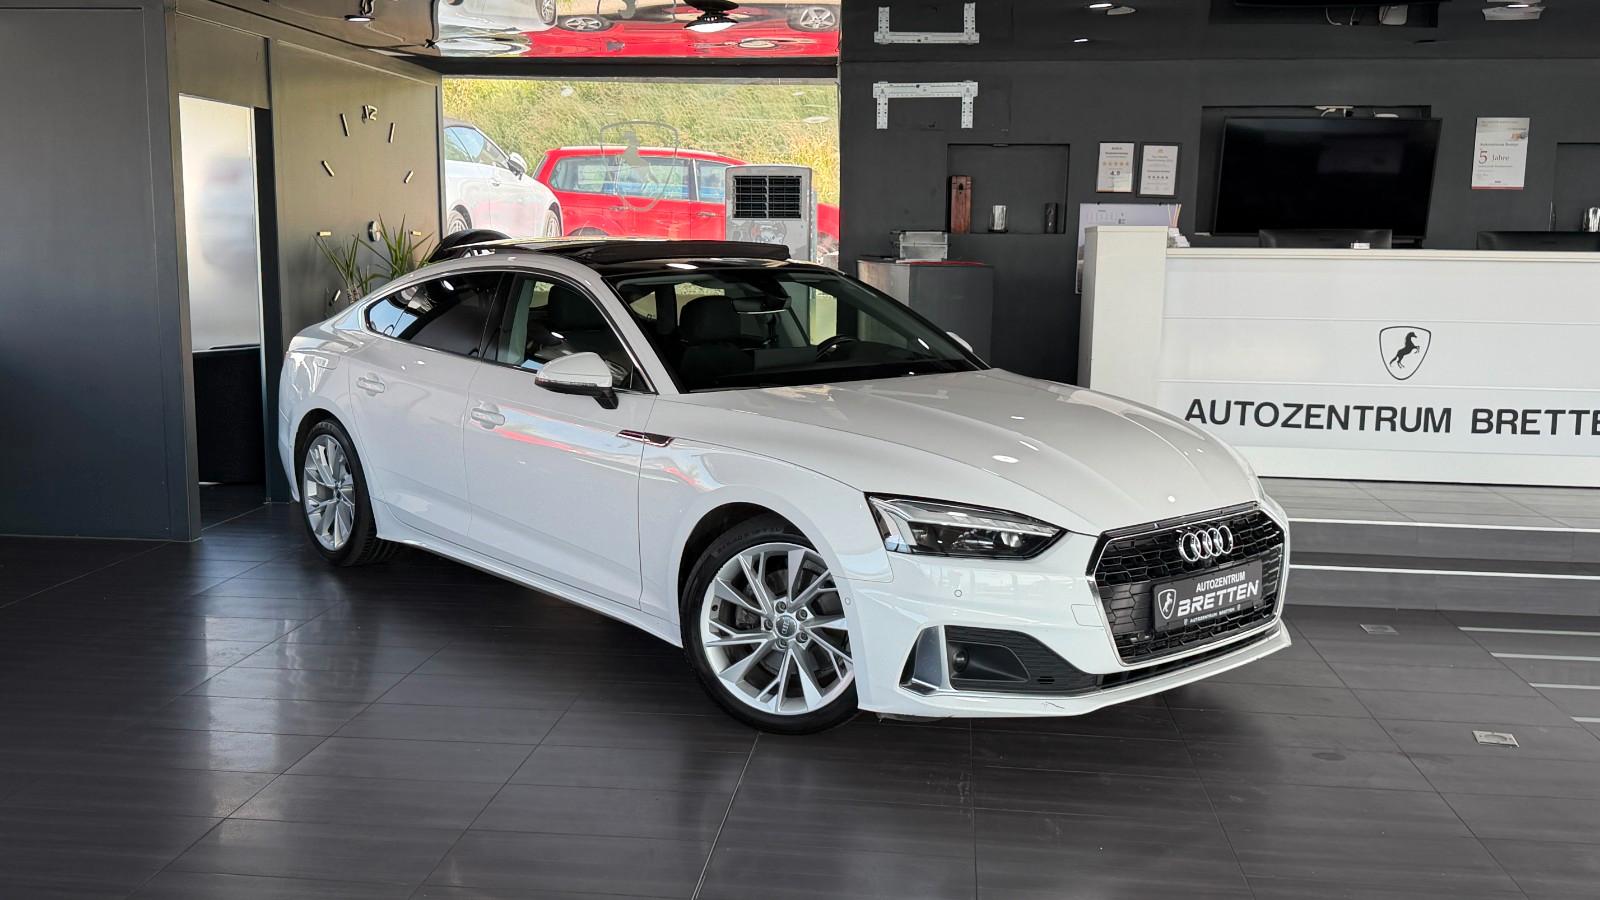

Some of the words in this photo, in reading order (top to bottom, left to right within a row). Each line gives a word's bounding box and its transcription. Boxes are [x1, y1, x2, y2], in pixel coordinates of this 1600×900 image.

[1478, 150, 1488, 165] 5
[1184, 398, 1452, 434] AUTOZENTRUM
[1195, 571, 1246, 593] AUTOZENTRUM
[1177, 579, 1260, 617] BRETTEN
